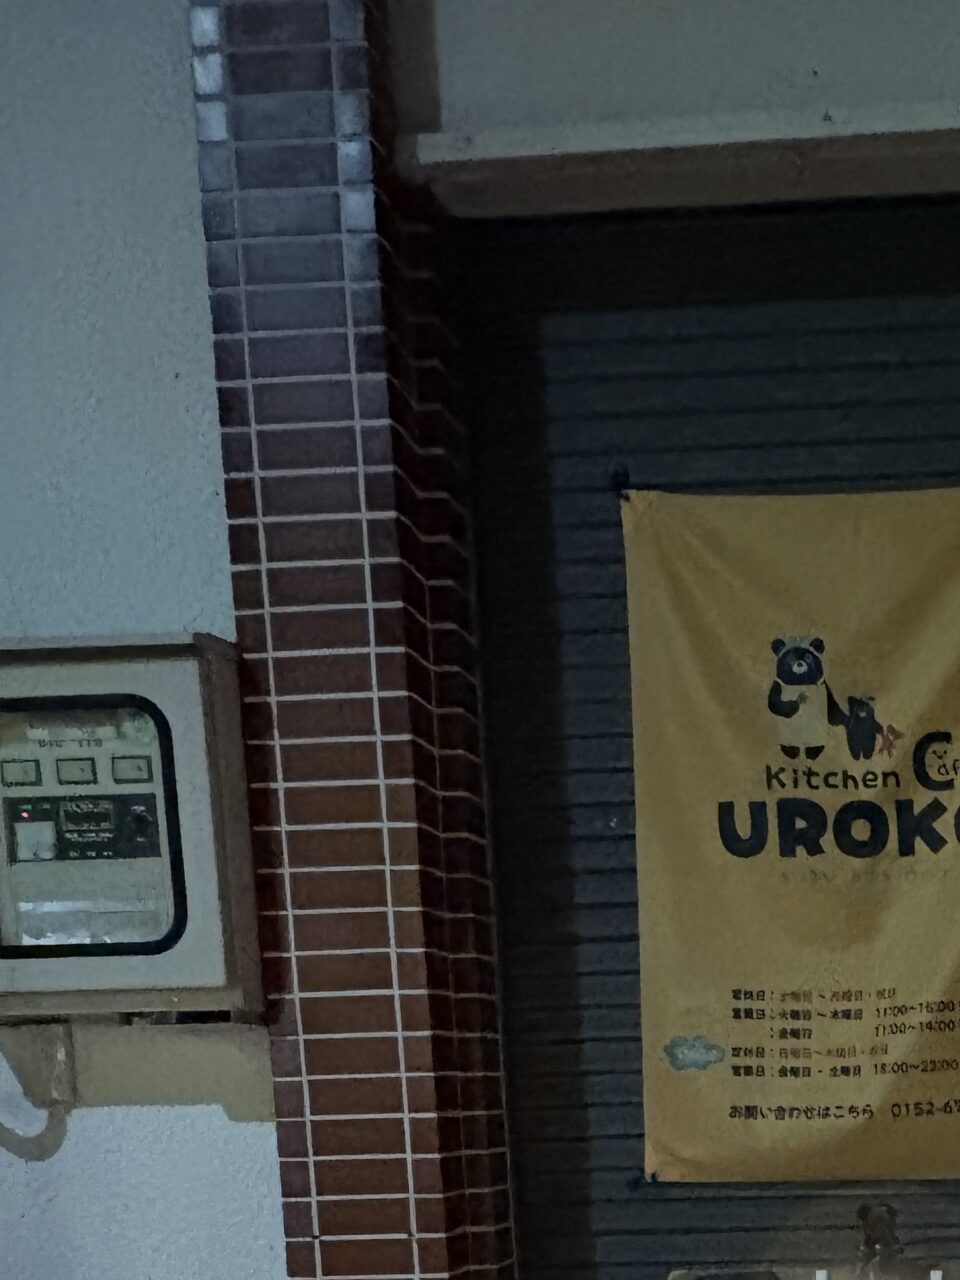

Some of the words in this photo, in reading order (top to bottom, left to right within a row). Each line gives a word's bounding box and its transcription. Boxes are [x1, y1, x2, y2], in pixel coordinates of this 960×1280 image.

[766, 765, 900, 790] Kitchen
[729, 1104, 874, 1120] お問い合わせはこちら
